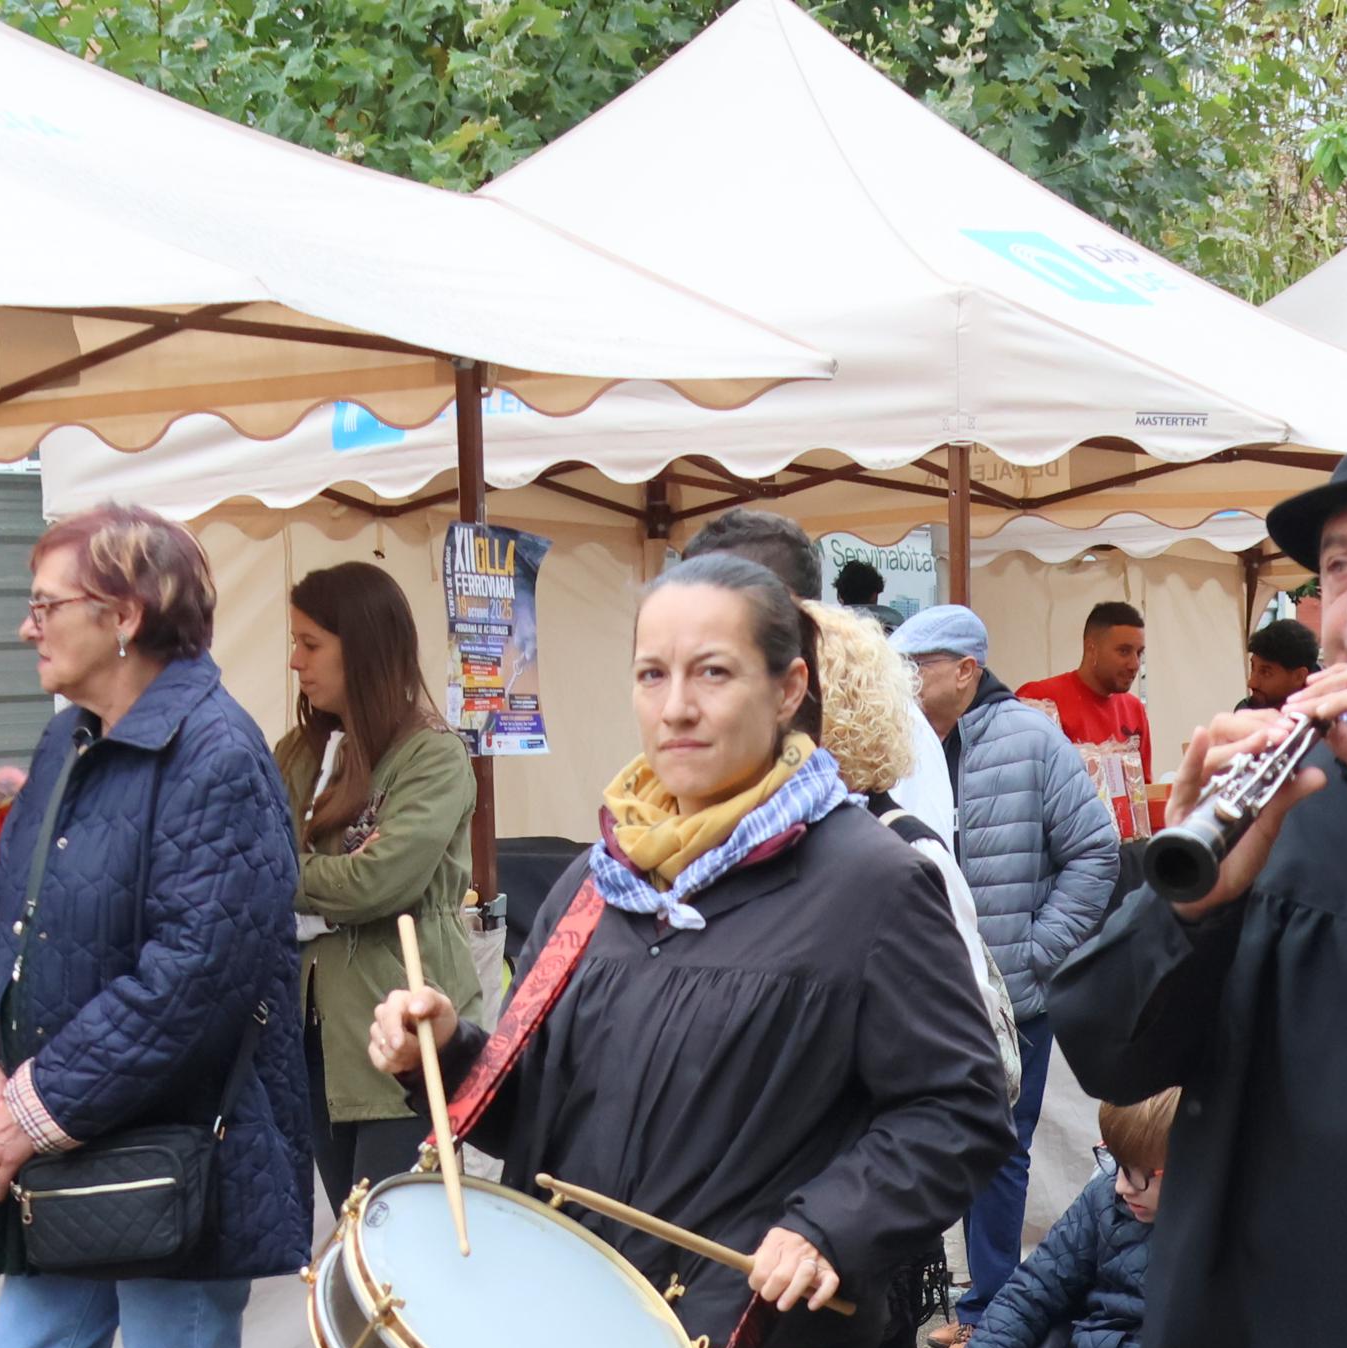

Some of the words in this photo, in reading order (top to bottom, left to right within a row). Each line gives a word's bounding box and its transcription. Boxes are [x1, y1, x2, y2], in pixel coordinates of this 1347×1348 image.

[1135, 416, 1208, 427] MASTERTENT
[454, 526, 476, 573] XII
[475, 537, 515, 576] OLLA
[830, 539, 933, 573] Servihabita
[454, 572, 515, 600] FERROVIARIA
[489, 598, 512, 620] 2025
